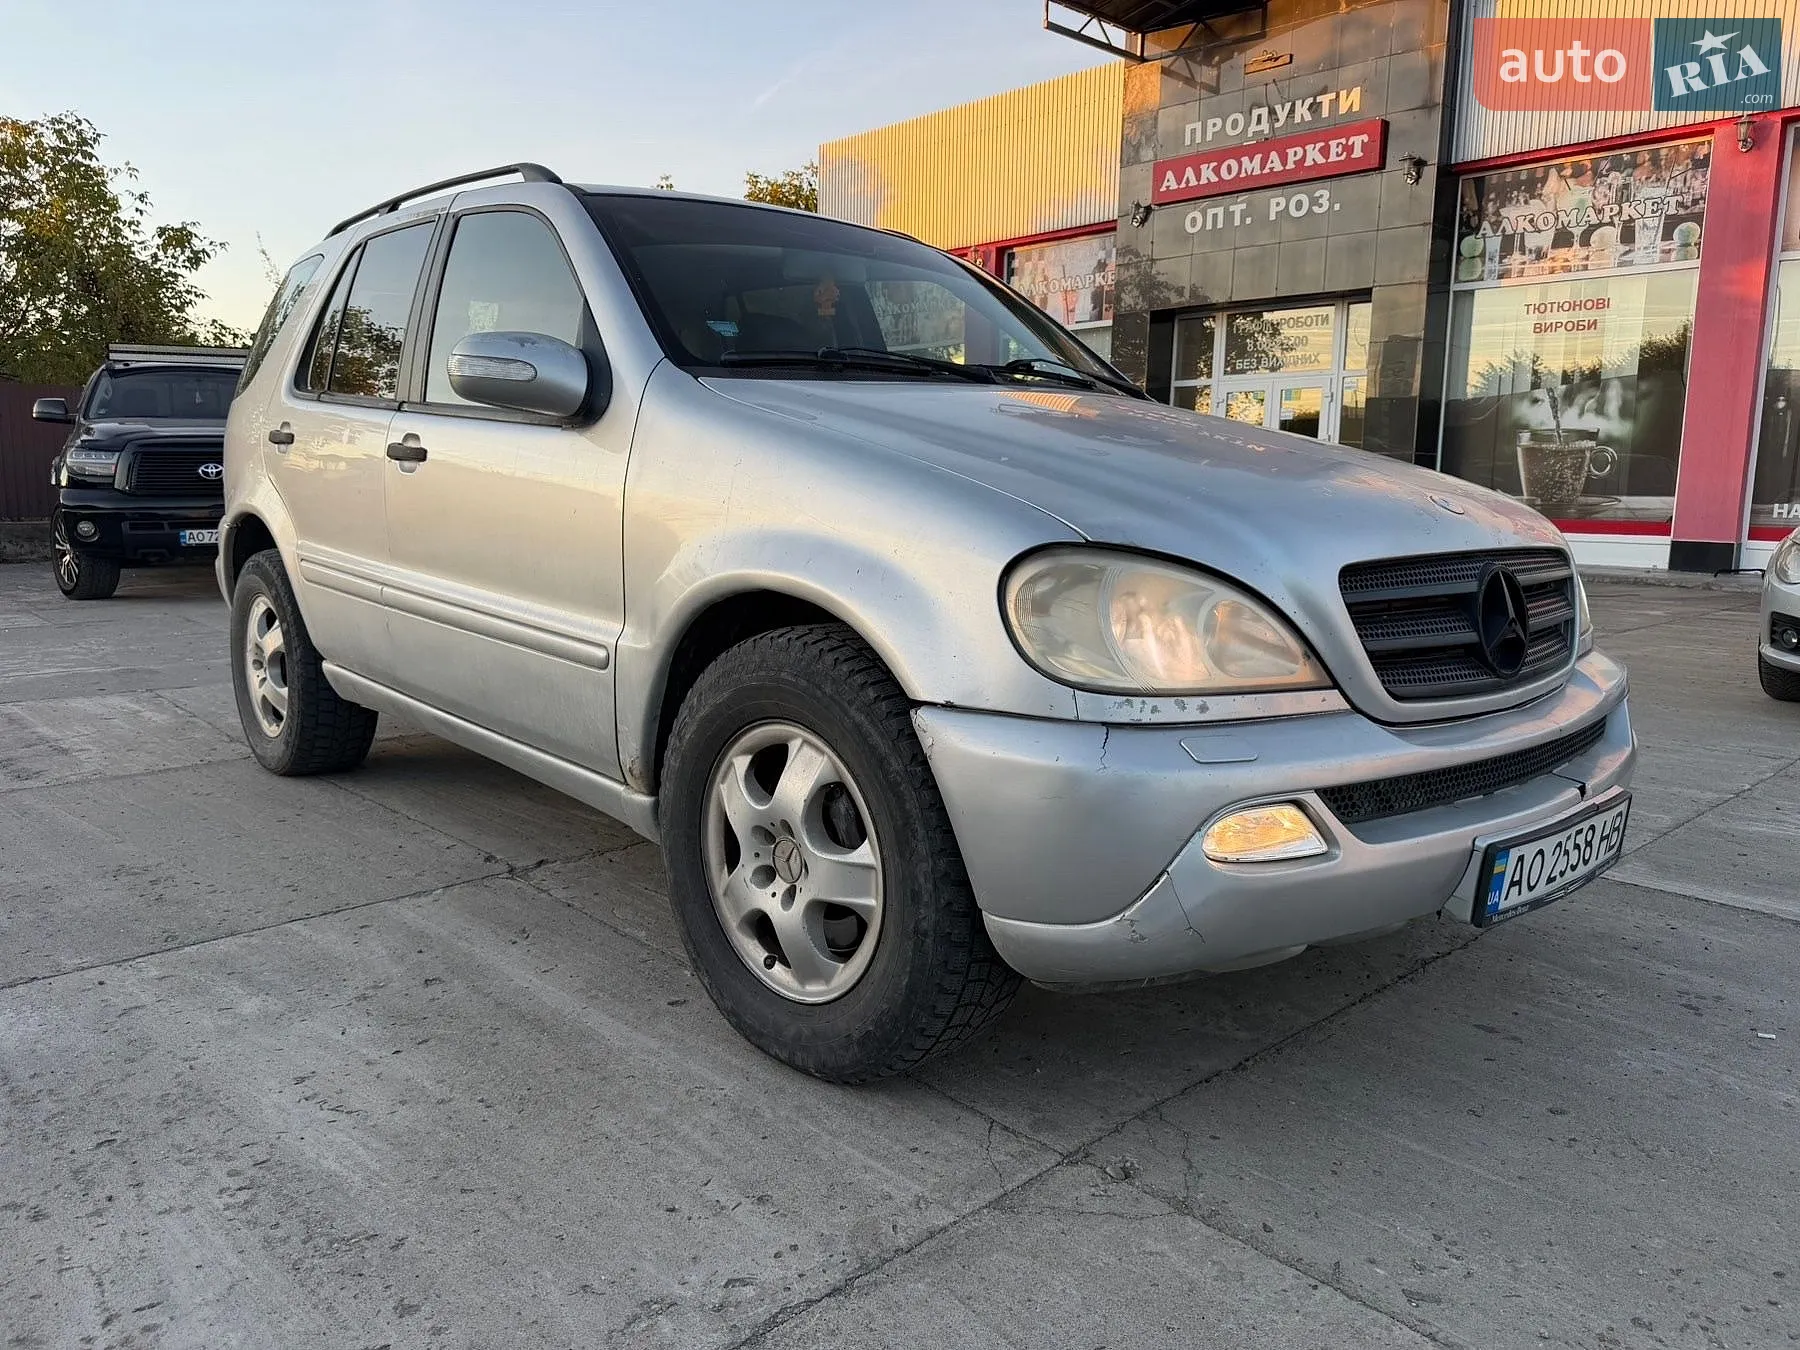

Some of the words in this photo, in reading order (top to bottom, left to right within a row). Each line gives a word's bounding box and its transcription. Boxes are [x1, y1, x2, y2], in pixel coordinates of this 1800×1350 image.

[1184, 86, 1362, 146] ПРОДУКТИ
[1159, 133, 1369, 192] АЛКОМАРКЕТ
[1184, 202, 1252, 234] ОПТ.
[1269, 189, 1341, 221] РОЗ.
[1475, 195, 1685, 239] АЛКОМАРКЕТ
[1280, 313, 1329, 330] РОБОТИ
[1524, 297, 1611, 316] ТЮТЮНОВІ
[1533, 319, 1598, 334] ВИРОБИ
[1236, 358, 1257, 370] БЕЗ
[1504, 848, 1545, 901] AO
[1545, 824, 1596, 886] 2558
[1595, 811, 1623, 861] HB
[1487, 890, 1500, 905] UA
